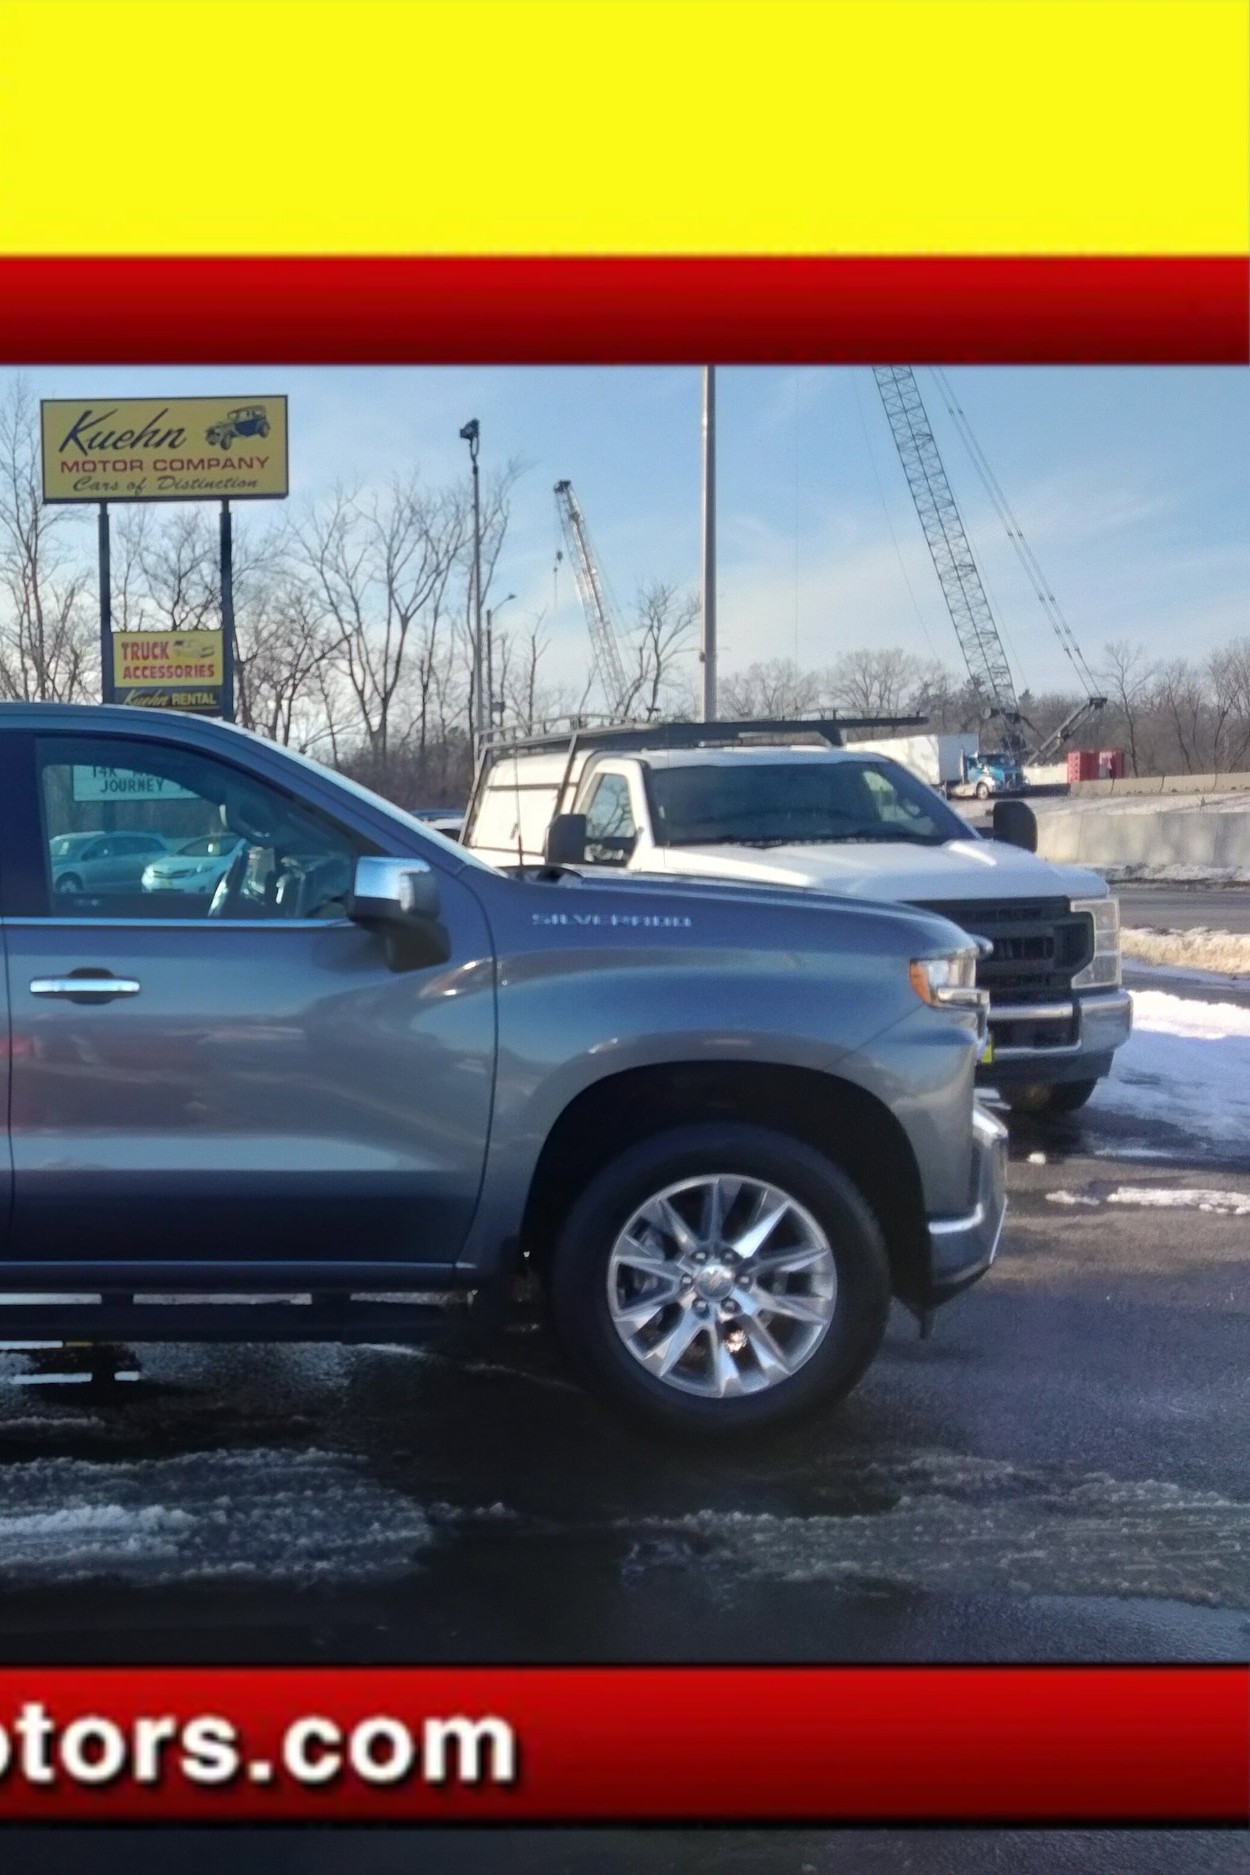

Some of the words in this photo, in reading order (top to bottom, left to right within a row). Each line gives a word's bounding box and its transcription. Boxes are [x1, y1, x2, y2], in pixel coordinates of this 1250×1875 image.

[58, 407, 187, 457] Kuehn
[60, 459, 144, 473] MOTOR
[152, 456, 270, 472] COMPANY
[72, 475, 119, 492] Cars
[126, 476, 148, 496] of
[156, 474, 259, 491] Distinction
[120, 640, 170, 661] TRUCK
[122, 663, 215, 680] ACCESSORIES
[171, 692, 217, 706] RENTAL
[99, 778, 164, 793] JOURNEY
[531, 913, 693, 927] SILVERADO
